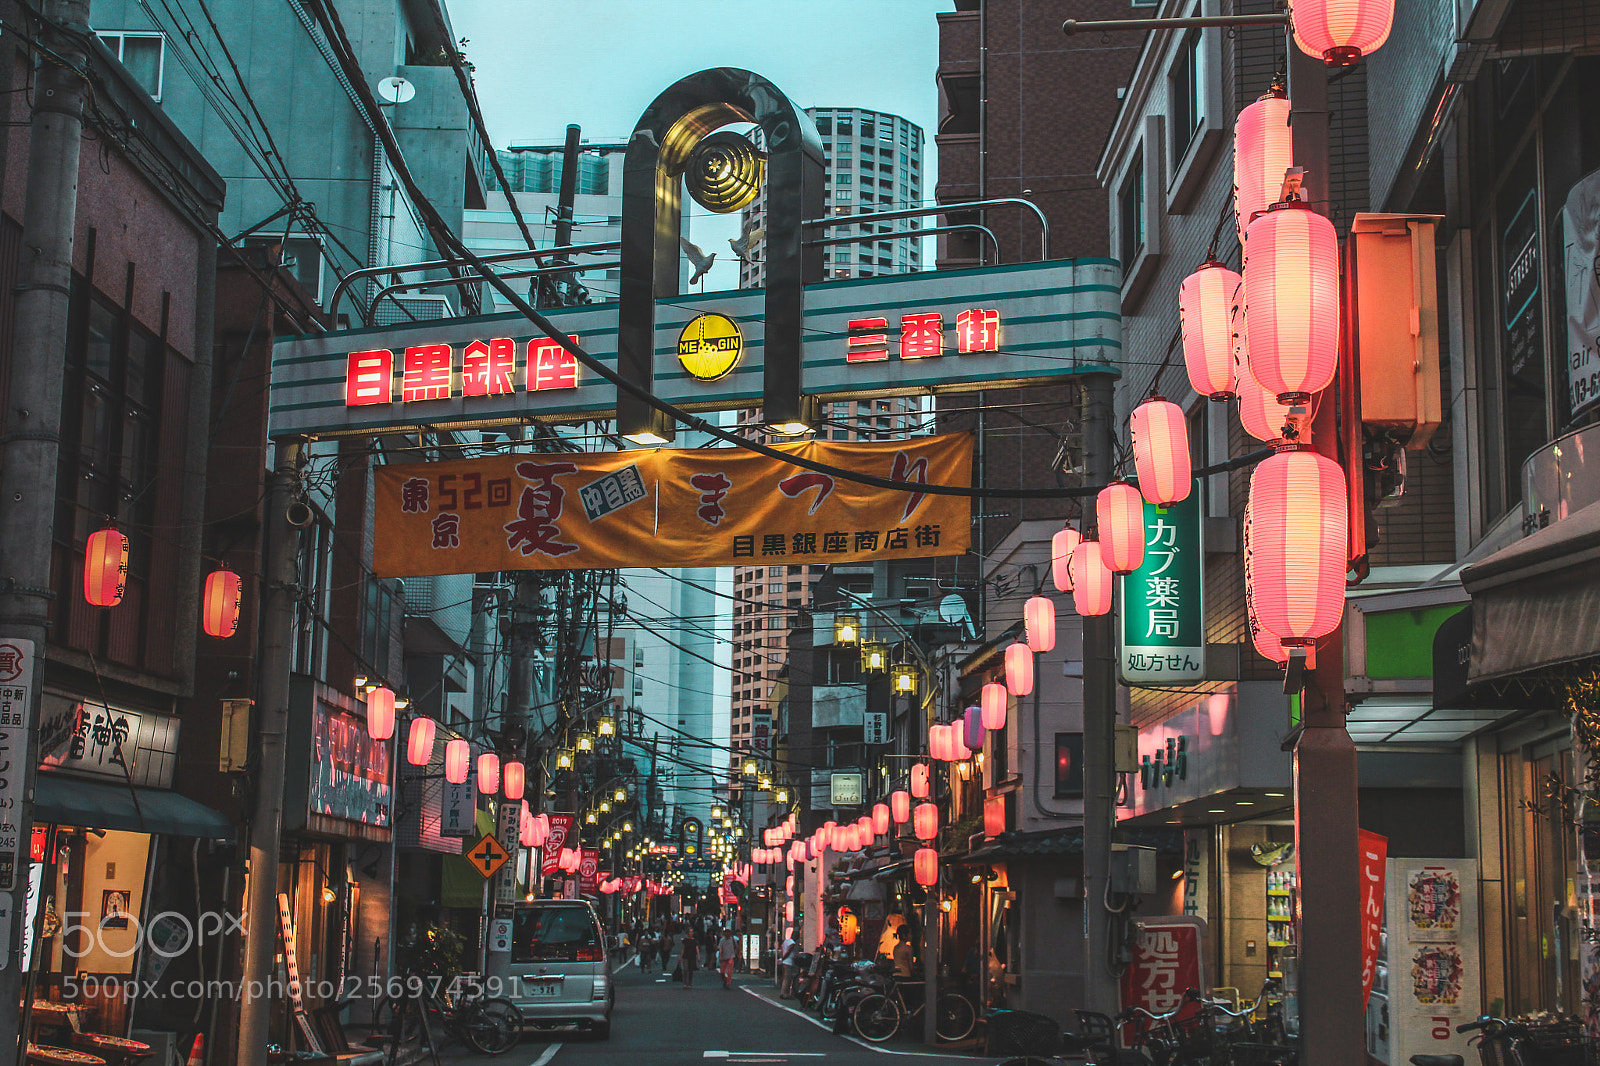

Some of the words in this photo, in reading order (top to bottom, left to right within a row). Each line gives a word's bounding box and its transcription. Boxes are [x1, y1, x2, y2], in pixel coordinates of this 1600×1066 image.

[846, 309, 1001, 364] 三番街
[1570, 345, 1592, 370] air
[345, 334, 580, 407] 目黒銀座
[732, 523, 941, 558] 目黒銀座商店街
[1145, 519, 1180, 639] カブ薬局
[1128, 653, 1199, 672] 処方せん
[1138, 931, 1182, 1030] 処方せ
